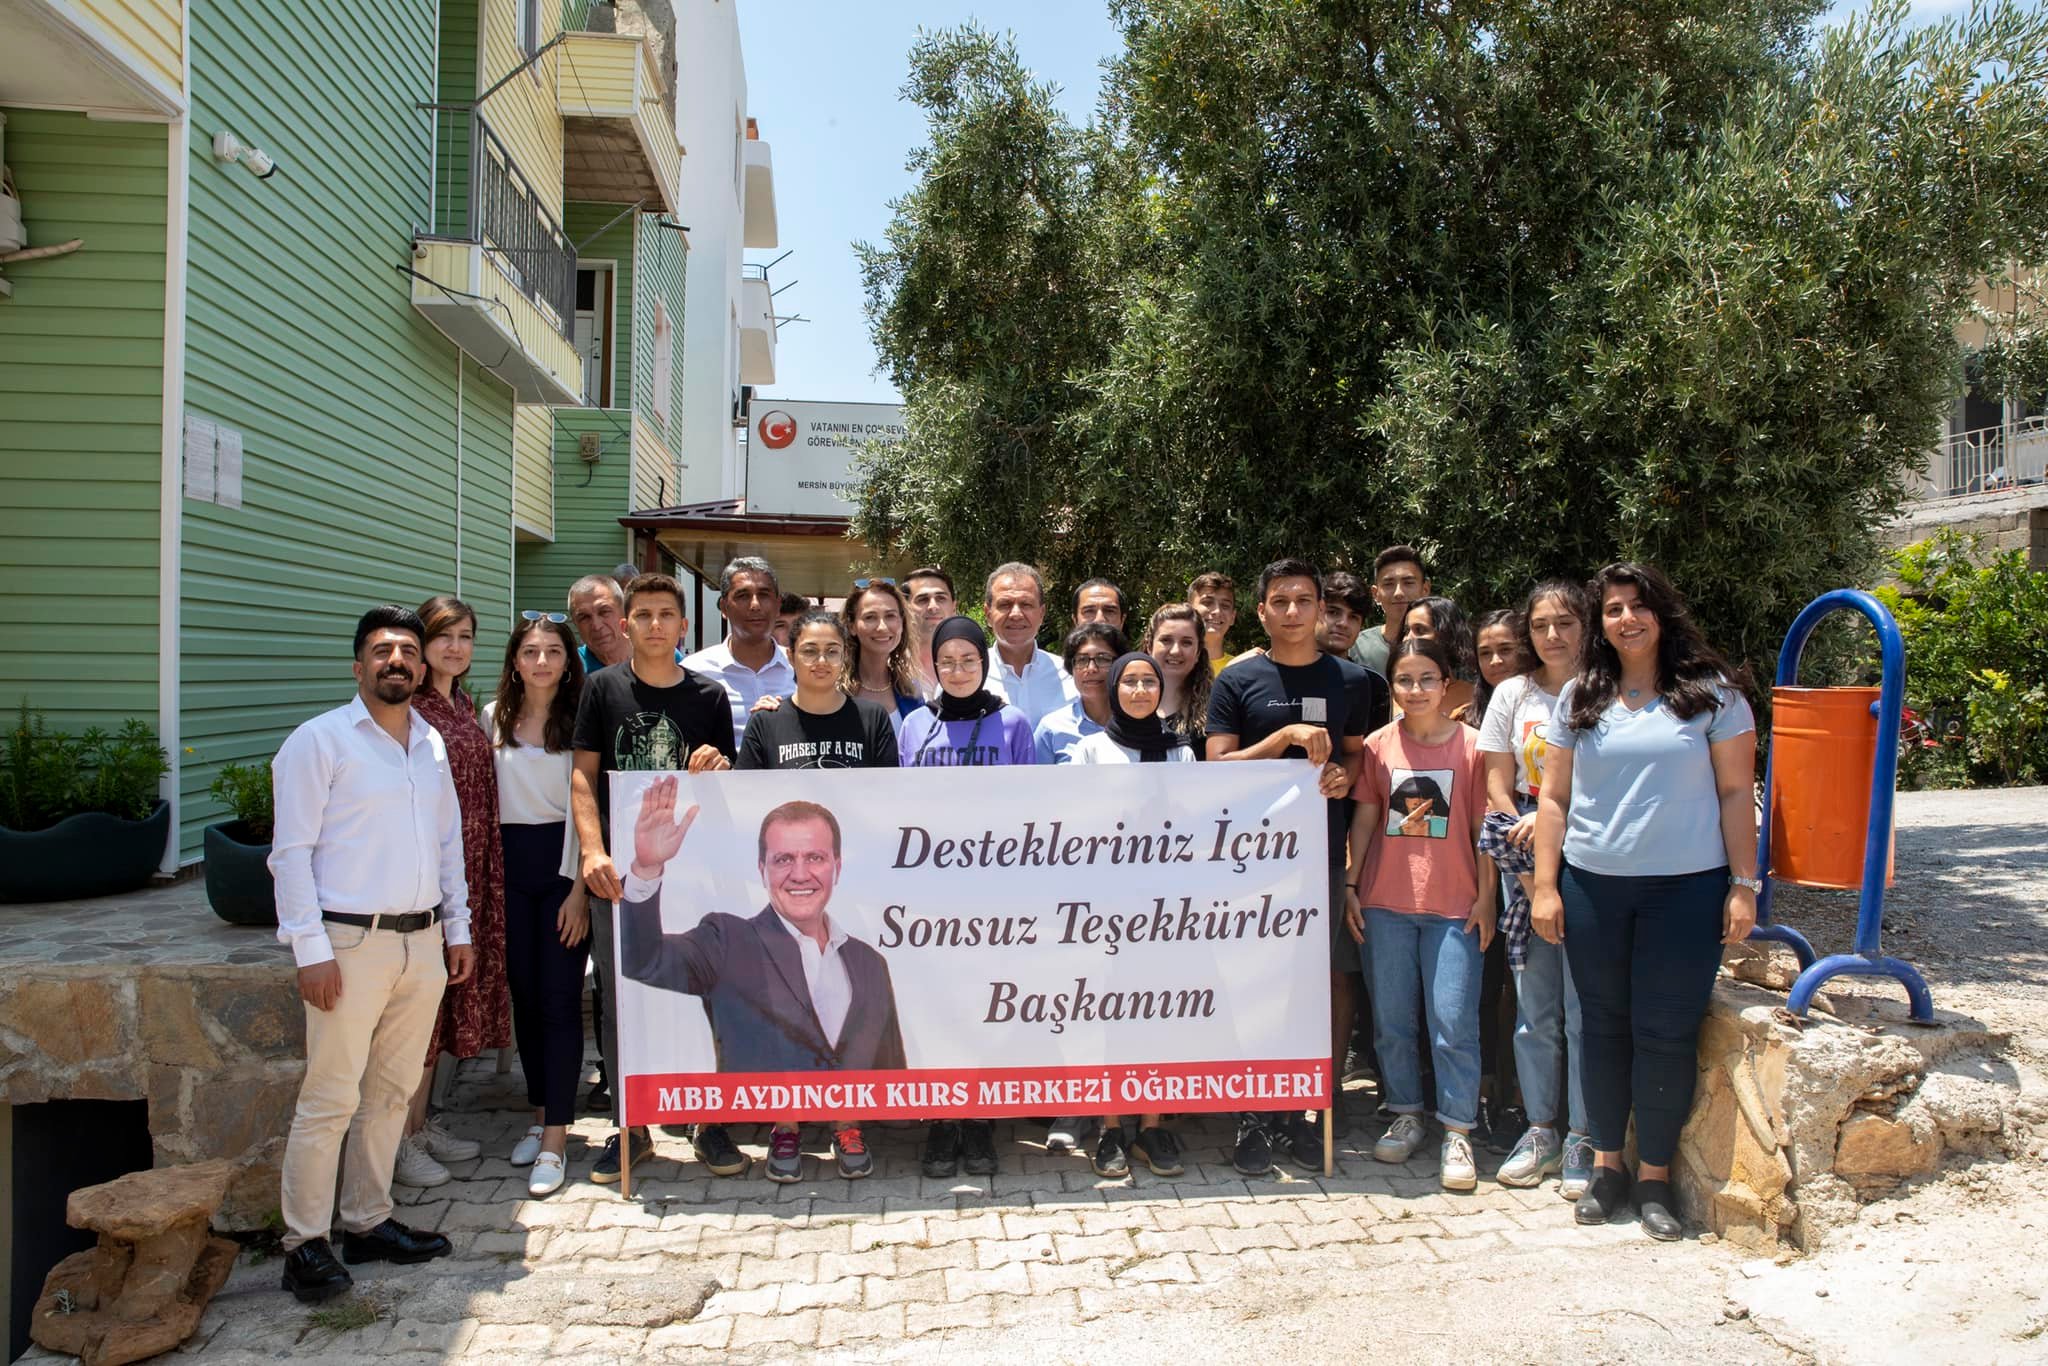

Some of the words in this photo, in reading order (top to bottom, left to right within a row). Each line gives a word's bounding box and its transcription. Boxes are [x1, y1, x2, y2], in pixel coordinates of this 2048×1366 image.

[810, 422, 850, 433] VATANINI
[852, 424, 863, 433] EN
[798, 480, 827, 489] MERSİN
[778, 742, 817, 763] PHASES
[819, 741, 832, 755] OF
[834, 741, 842, 755] A
[845, 741, 863, 761] CAT
[891, 821, 1195, 869] Destekleriniz
[1207, 808, 1299, 874] İçin
[878, 904, 1038, 948] Sonsuz
[1055, 894, 1319, 956] Teşekkürler
[983, 977, 1216, 1035] Başkanım
[657, 1086, 724, 1112] MBB
[730, 1083, 878, 1111] AYDINCIK
[885, 1081, 969, 1108] KURS
[977, 1071, 1112, 1105] MERKEZİ
[1120, 1065, 1324, 1103] ÖĞRENCİLERİ
